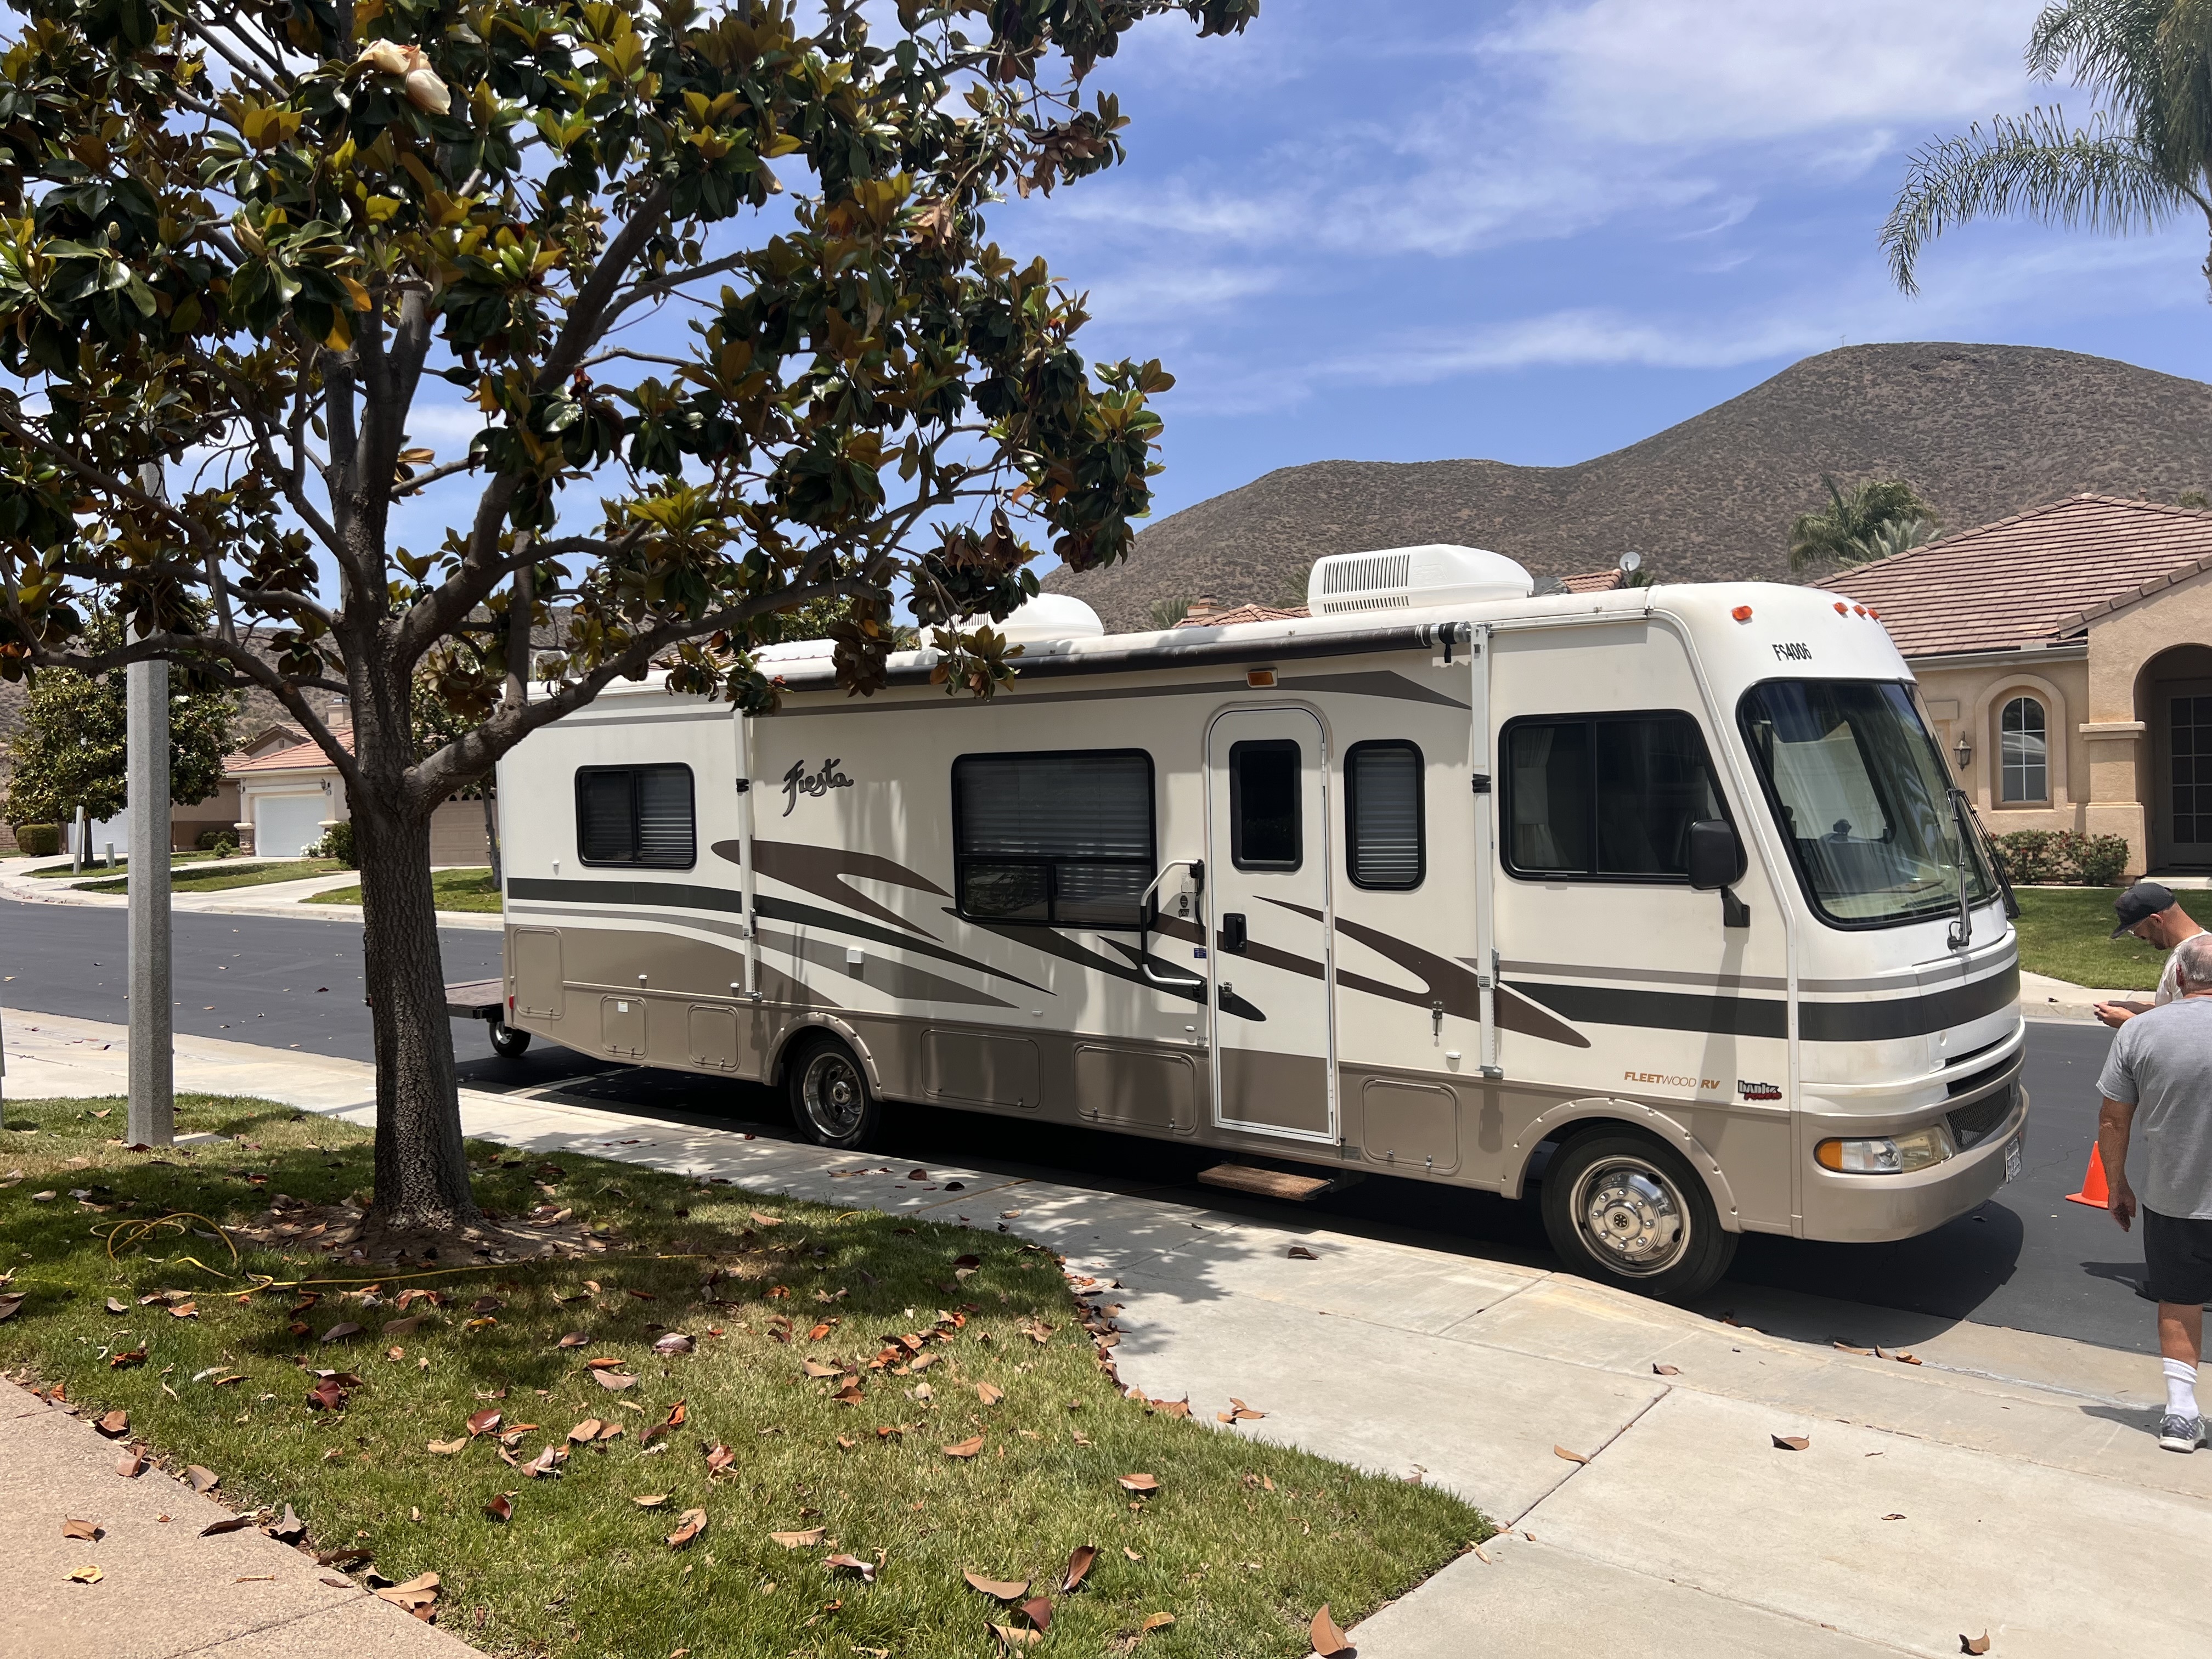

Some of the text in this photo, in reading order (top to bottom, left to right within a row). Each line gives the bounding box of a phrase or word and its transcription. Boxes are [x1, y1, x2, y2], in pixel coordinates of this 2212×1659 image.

[1771, 642, 1812, 661] FS4006
[782, 758, 854, 817] Fiesta
[1624, 1071, 1720, 1090] FLEETWOOD RV
